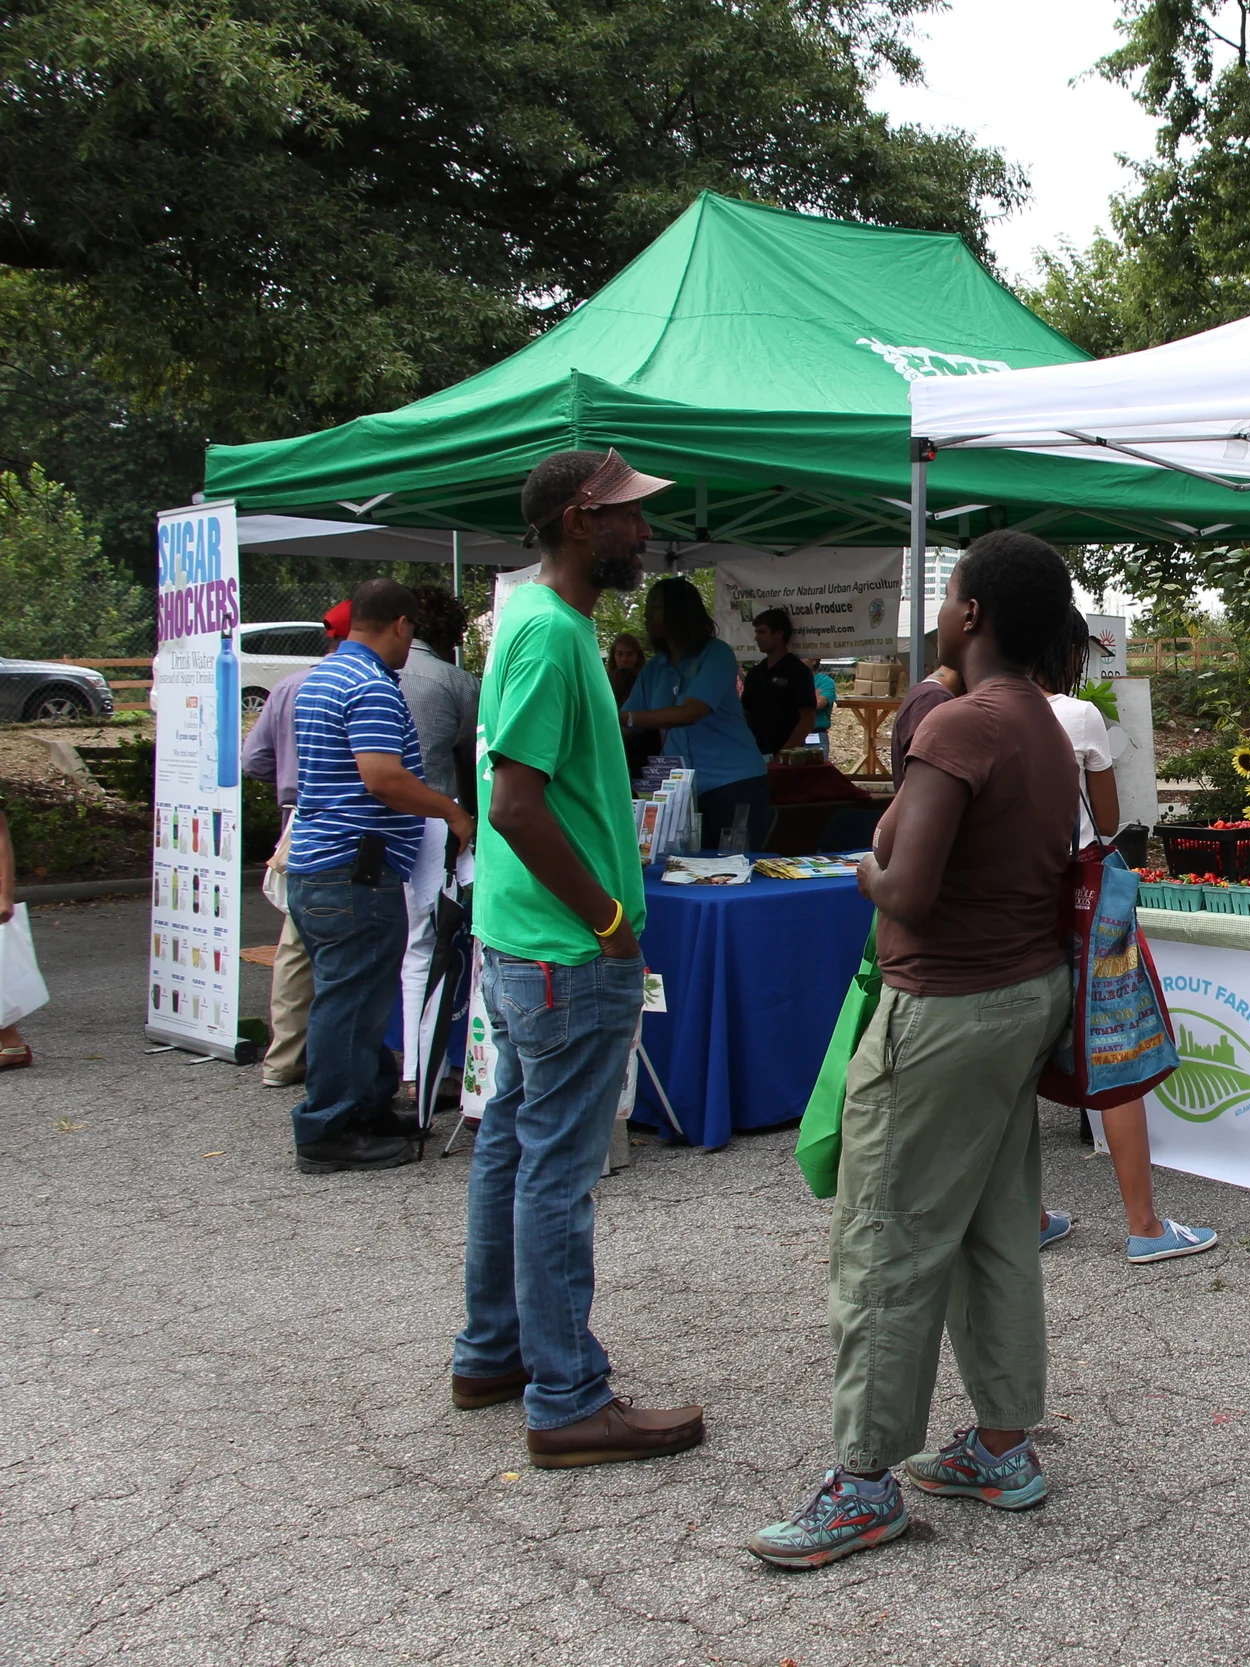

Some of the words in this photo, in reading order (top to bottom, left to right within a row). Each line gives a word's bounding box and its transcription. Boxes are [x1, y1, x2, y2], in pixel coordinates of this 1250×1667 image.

[158, 516, 221, 588] SUGAR
[756, 588, 782, 599] Center
[783, 587, 795, 597] for
[797, 584, 826, 596] Natural
[828, 583, 851, 595] Urban
[852, 578, 899, 594] Agriculture
[157, 577, 238, 642] SHOCKERS
[791, 602, 813, 616] Local
[815, 601, 853, 616] Produce
[172, 651, 190, 670] Drink
[191, 651, 215, 670] Water
[1098, 925, 1125, 938] WAR
[1090, 1023, 1125, 1036] YUMMY
[1090, 1035, 1127, 1046] ORGANIC
[1092, 1052, 1129, 1065] WARM
[1138, 1034, 1162, 1053] ASTY
